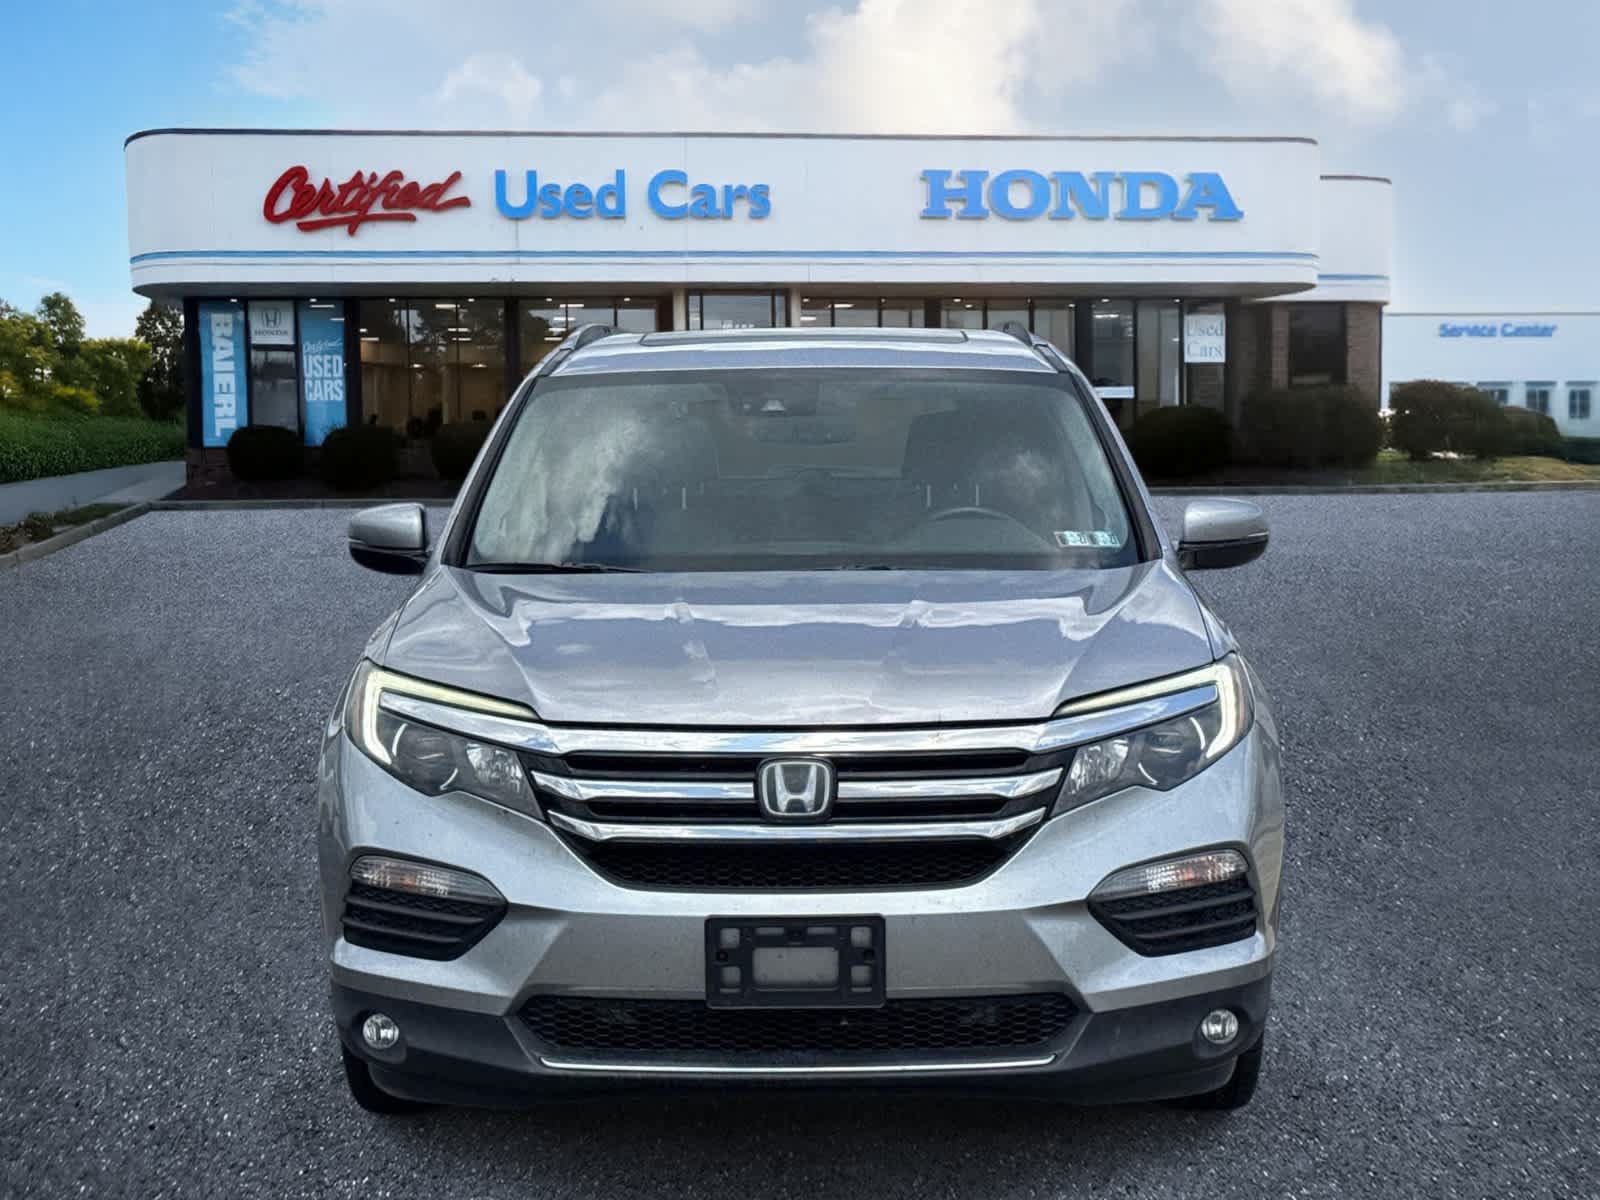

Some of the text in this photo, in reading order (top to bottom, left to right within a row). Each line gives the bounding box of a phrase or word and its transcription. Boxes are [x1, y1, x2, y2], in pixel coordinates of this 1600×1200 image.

[264, 166, 771, 236] Certified Used Cars
[920, 169, 1244, 221] HONDA
[254, 328, 288, 337] HONDA
[1187, 319, 1224, 336] Used
[1439, 323, 1557, 337] Service Center
[211, 313, 237, 437] BAIERL
[303, 354, 342, 378] USED
[305, 379, 343, 401] CARS
